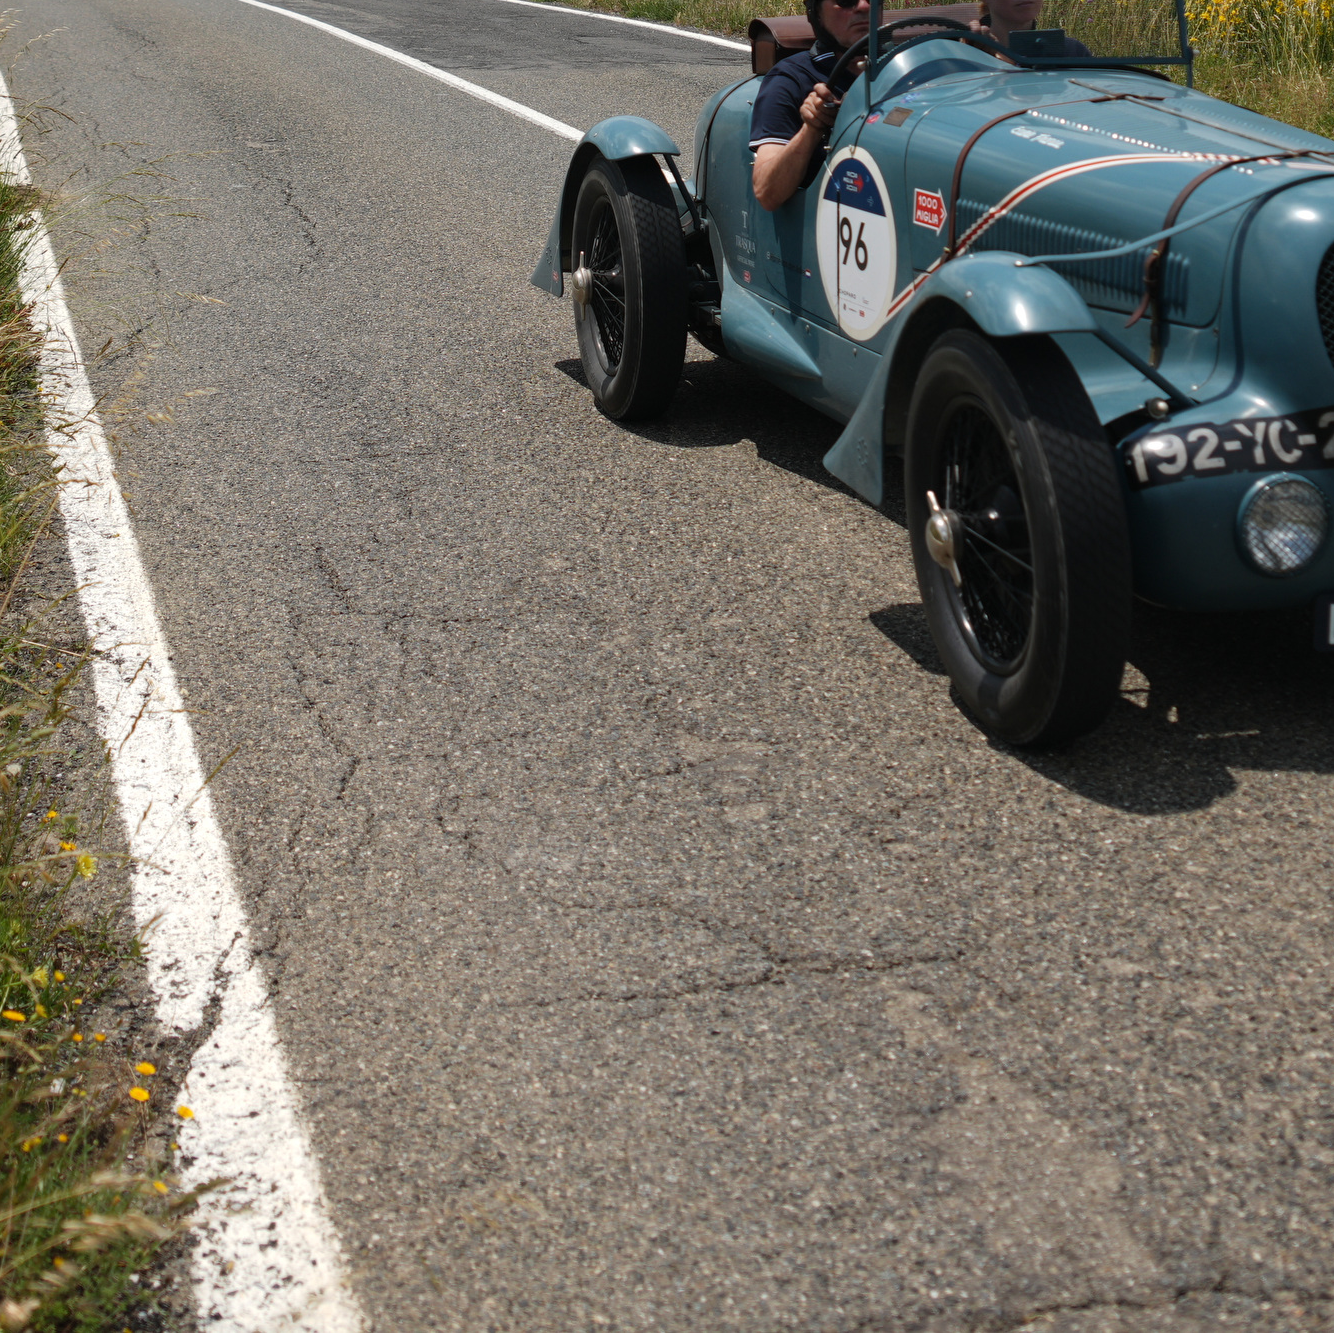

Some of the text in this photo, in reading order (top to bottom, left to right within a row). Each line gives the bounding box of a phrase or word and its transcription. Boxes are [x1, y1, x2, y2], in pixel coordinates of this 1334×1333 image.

[918, 195, 938, 210] 1000
[917, 209, 939, 225] MIGLIA
[840, 216, 869, 271] 96
